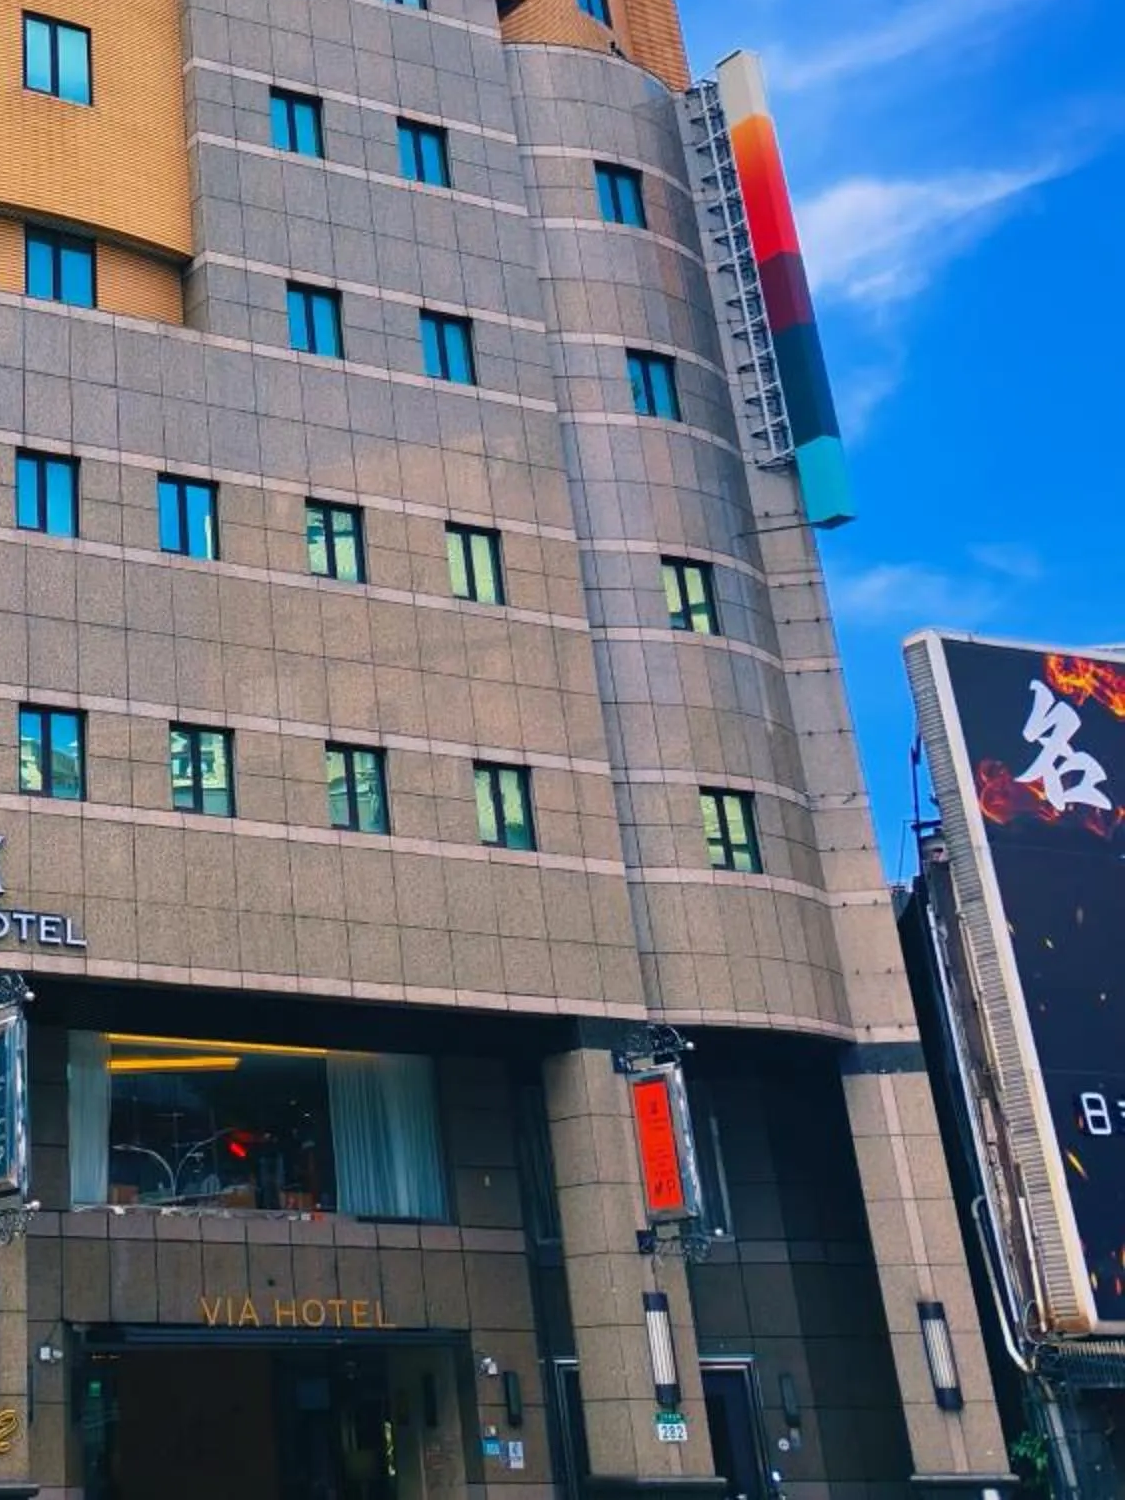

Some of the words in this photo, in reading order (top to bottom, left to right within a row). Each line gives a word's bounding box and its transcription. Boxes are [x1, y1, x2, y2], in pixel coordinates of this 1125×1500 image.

[1014, 679, 1112, 812] 名
[200, 1296, 260, 1328] VIA
[275, 1299, 396, 1329] HOTEL
